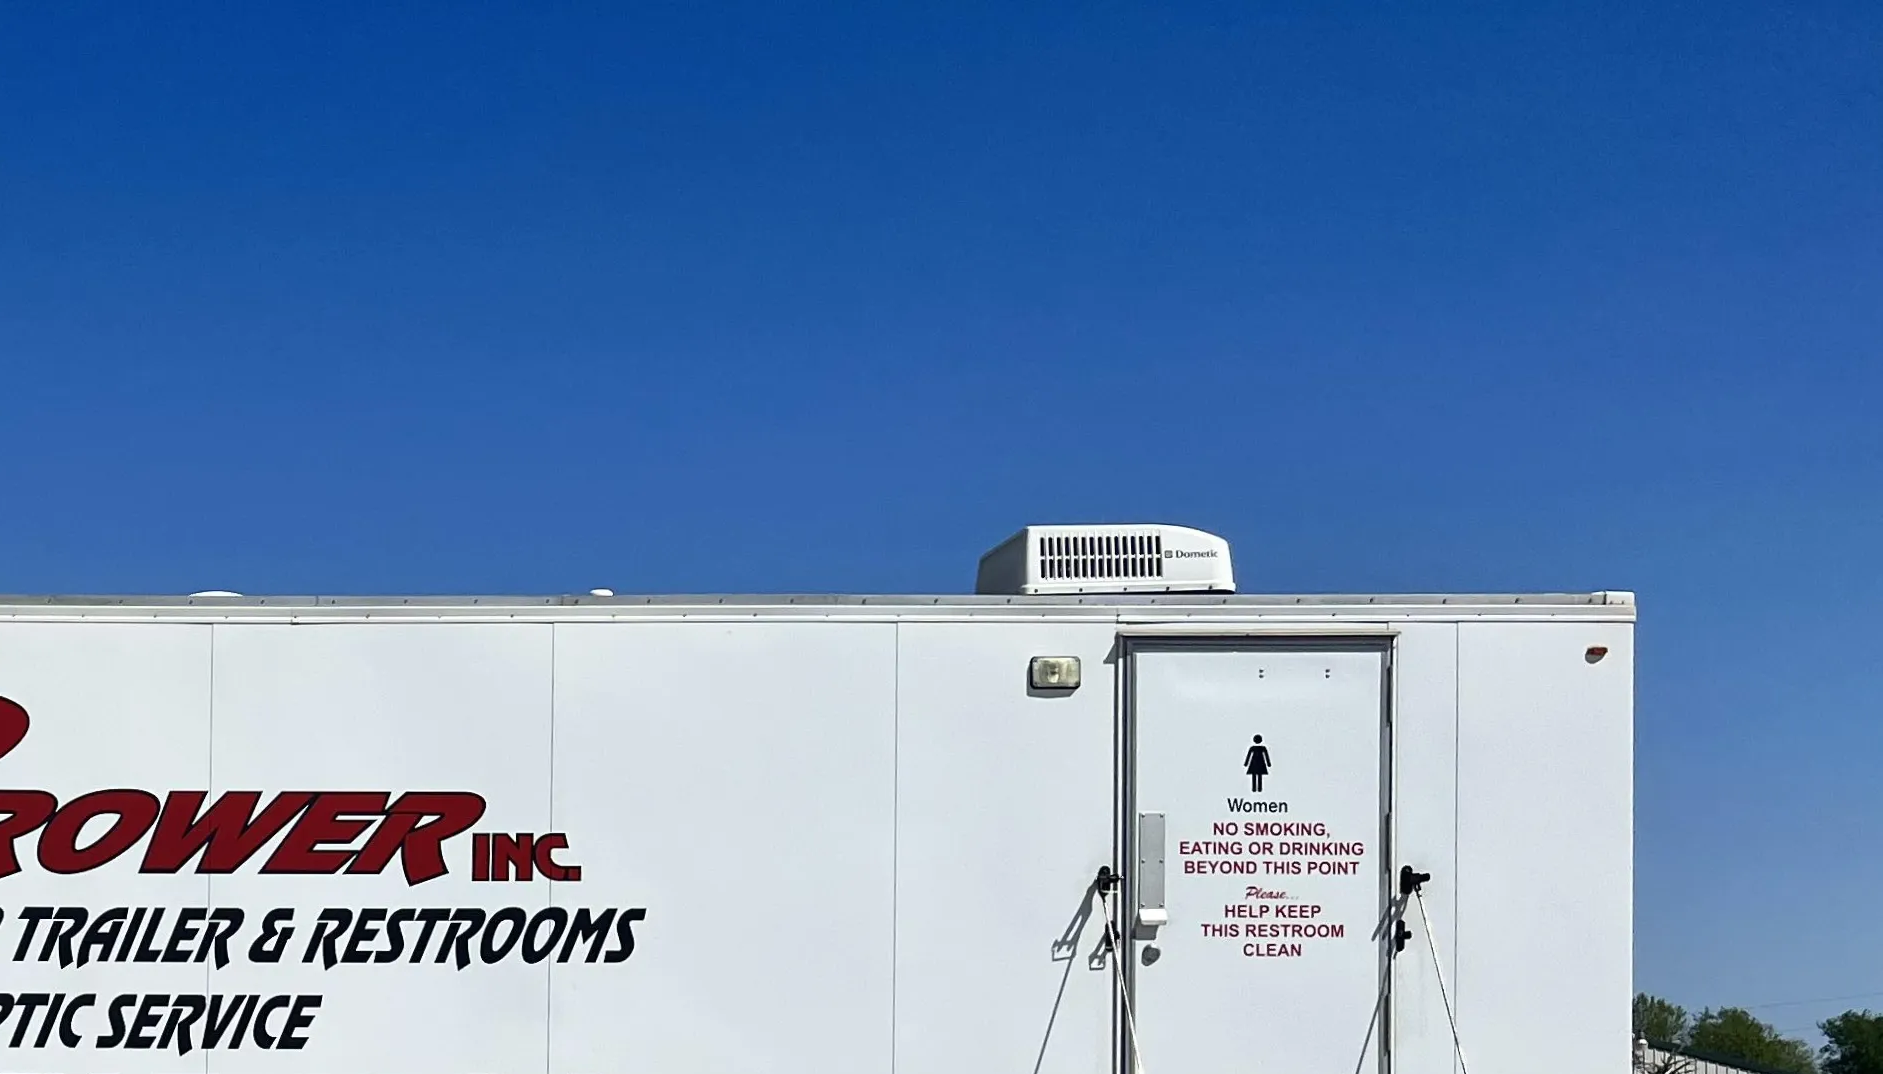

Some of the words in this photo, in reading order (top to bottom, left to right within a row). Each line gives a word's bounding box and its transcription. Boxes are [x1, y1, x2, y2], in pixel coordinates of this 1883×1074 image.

[1175, 550, 1218, 558] Dometic
[1227, 798, 1288, 812] Women
[1213, 822, 1238, 835] NO
[1244, 823, 1330, 838] SMOKING,
[1179, 842, 1242, 855] EATING
[1249, 842, 1273, 855] OR
[1280, 843, 1364, 855] DRINKING
[1184, 861, 1257, 874] BEYOND
[1263, 862, 1301, 874] THIS
[1307, 862, 1360, 875] POINT
[1224, 905, 1269, 918] HELP
[1275, 905, 1321, 918] KEEP
[1201, 924, 1239, 937] THIS
[1245, 924, 1344, 938] RESTROOM
[13, 907, 244, 970] TRAILER
[249, 921, 293, 962] &
[302, 907, 646, 971] RESTROOMS
[1243, 944, 1302, 957] CLEAN
[96, 994, 322, 1056] SERVICE
